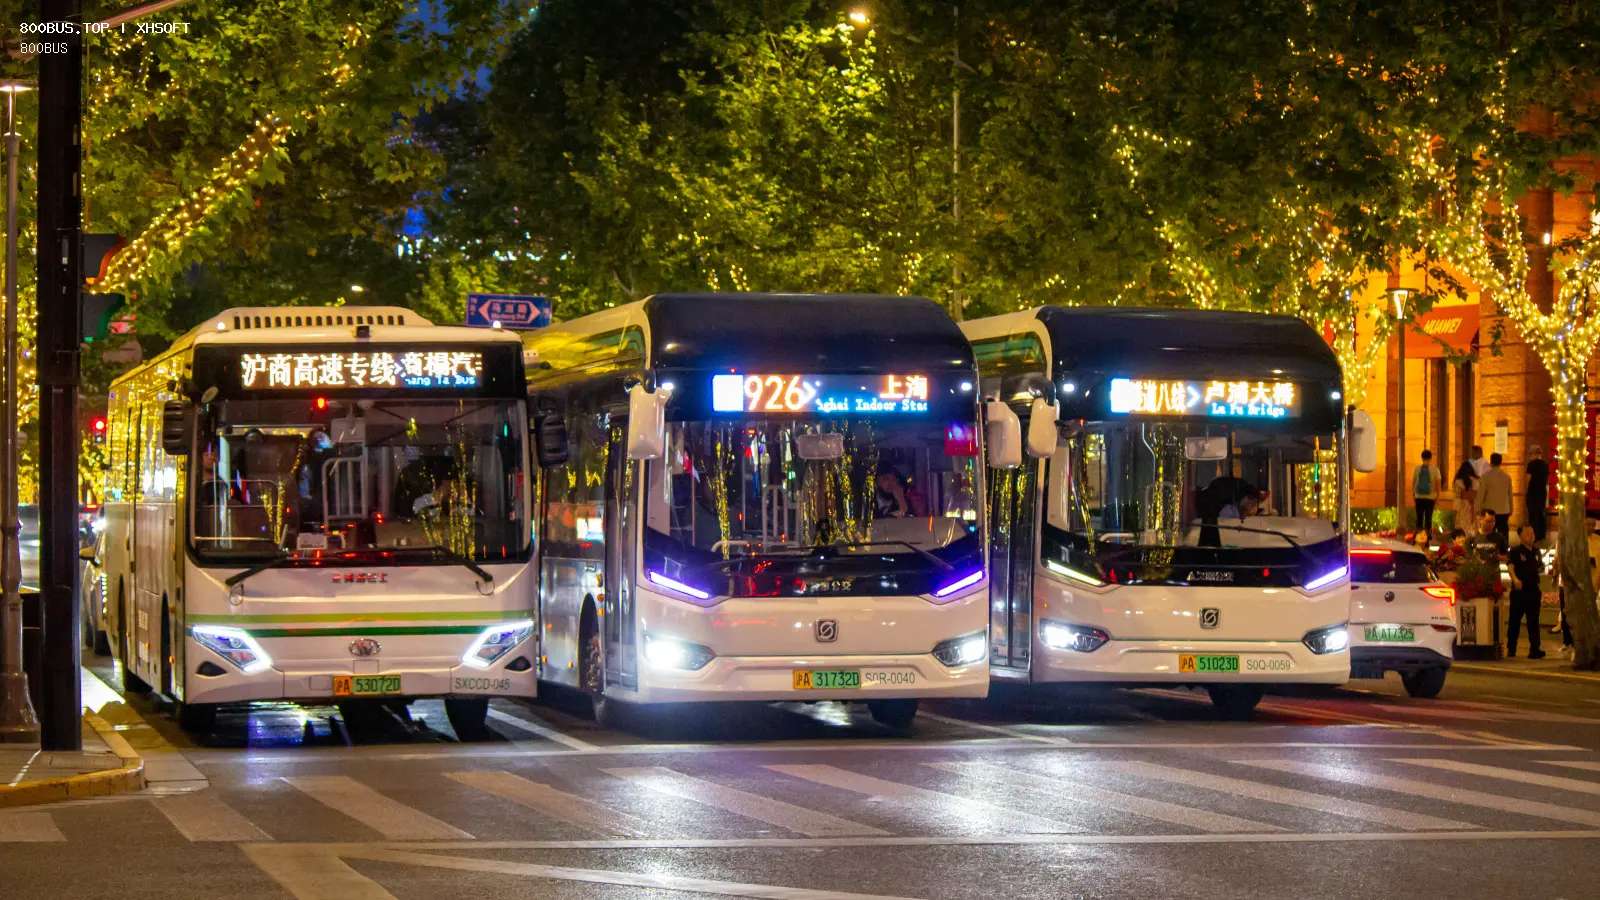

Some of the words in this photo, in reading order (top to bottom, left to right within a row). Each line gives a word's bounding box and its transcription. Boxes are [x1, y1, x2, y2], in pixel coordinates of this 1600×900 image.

[1423, 317, 1463, 334] HUAWEI
[241, 352, 396, 387] 沪商高速专线
[743, 375, 803, 411] 926
[855, 397, 897, 411] Indoor
[1199, 656, 1239, 671] 51023D
[355, 677, 400, 693] 53072D
[454, 677, 511, 691] SXCCD-045
[816, 671, 860, 687] 31732D
